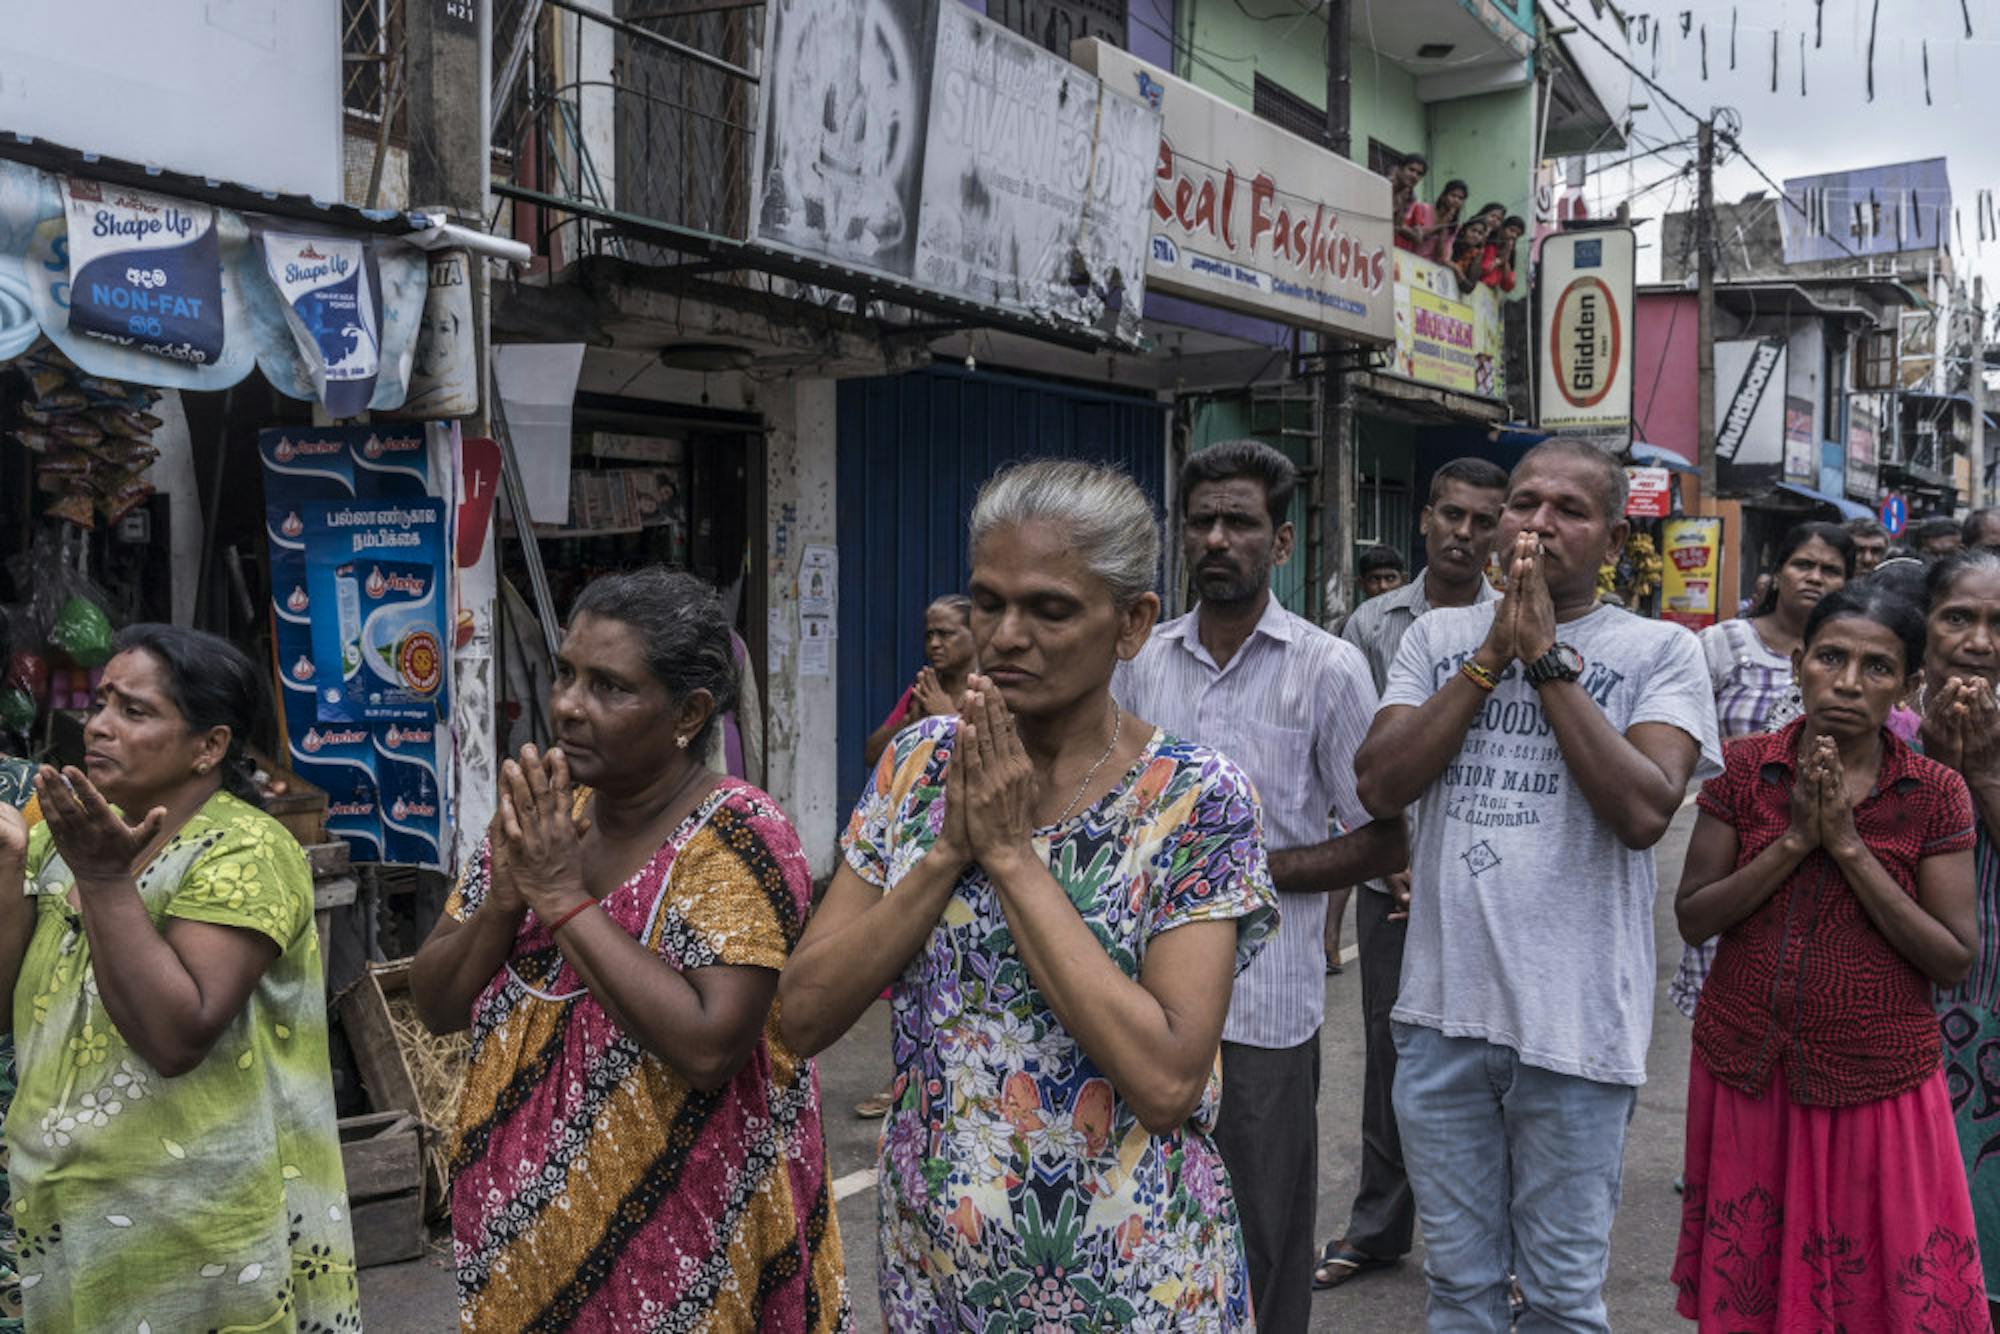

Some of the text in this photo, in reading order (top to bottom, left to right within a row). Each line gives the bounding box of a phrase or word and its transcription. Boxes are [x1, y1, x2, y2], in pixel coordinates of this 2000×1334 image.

[93, 208, 192, 240] Shape Up
[1250, 174, 1386, 293] Fashions
[285, 254, 349, 283] Shape Up
[91, 283, 203, 319] NON-FAT
[1573, 293, 1595, 391] Glidden
[353, 529, 421, 552] நம்பிக்கை
[1445, 765, 1559, 794] UNION MADE
